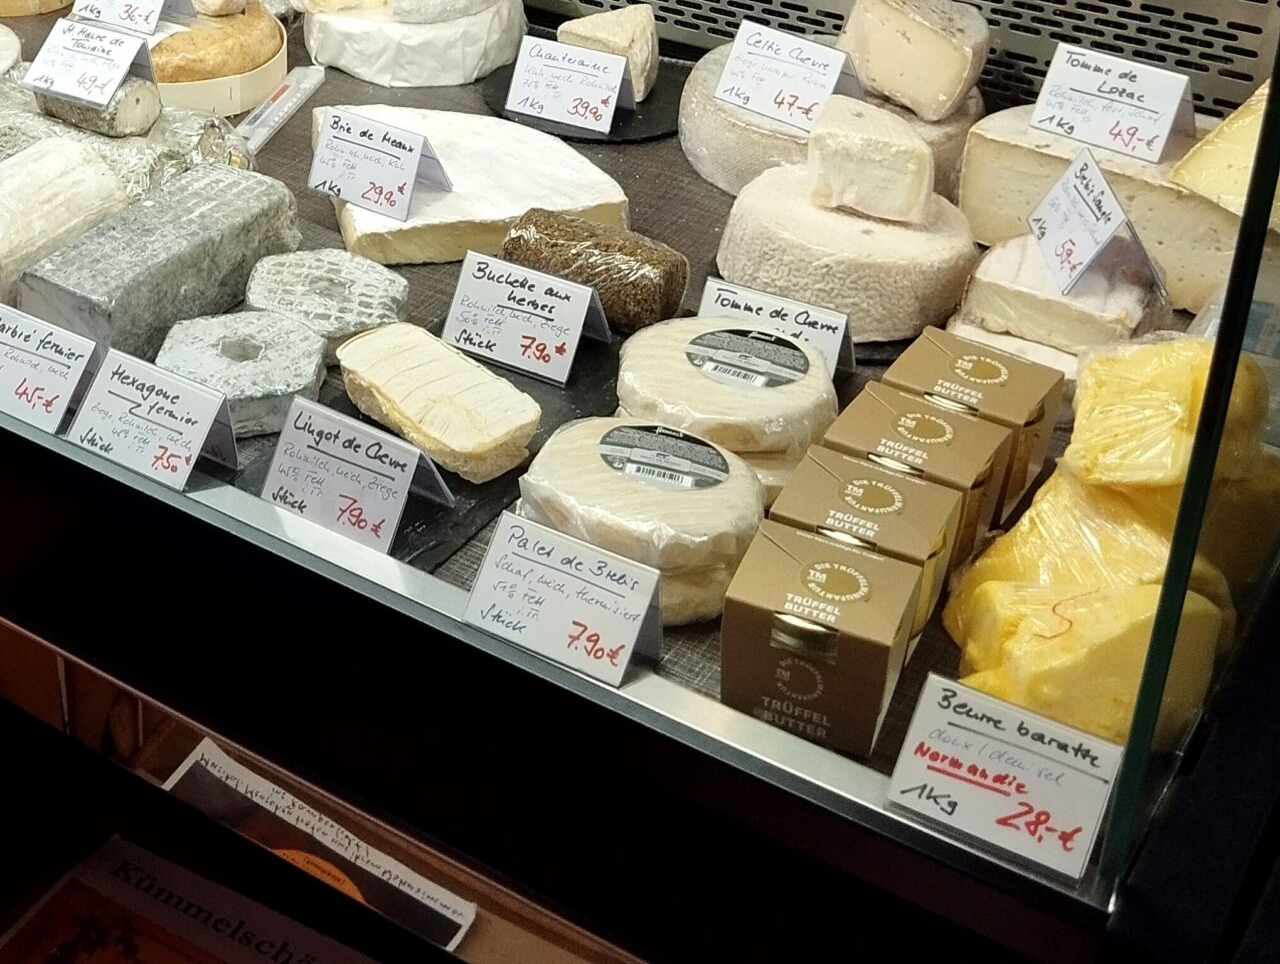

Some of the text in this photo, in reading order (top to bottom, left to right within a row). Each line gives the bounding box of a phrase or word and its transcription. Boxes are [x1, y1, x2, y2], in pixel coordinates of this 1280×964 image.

[109, 36, 125, 46] de
[746, 32, 781, 55] Celtic
[1066, 50, 1137, 83] Tomme de
[330, 115, 415, 154] Brie de Meaux
[543, 287, 572, 302] aux
[715, 288, 763, 316] Tomme
[769, 307, 788, 321] de
[36, 331, 85, 362] fermier
[454, 328, 497, 353] Stück
[111, 363, 181, 405] Hexagone
[933, 386, 978, 404] BUTTER
[935, 379, 983, 400] TRÜFFEL
[147, 401, 199, 427] fermier
[293, 410, 341, 447] Lingot
[342, 437, 362, 454] de
[876, 445, 924, 465] BUTTER
[879, 437, 929, 460] TRÜFFEL
[271, 486, 308, 514] Stück
[826, 517, 876, 538] BUTTER
[828, 509, 880, 532] TRÜFFEL
[507, 524, 640, 591] Palet de Brebis
[784, 602, 837, 623] BUTTER
[785, 593, 841, 615] TRÜFFEL
[480, 603, 527, 633] Stück
[761, 695, 831, 727] TRÜFFEL
[937, 687, 1100, 768] Beurre baratte
[913, 740, 1029, 795] Normandie
[995, 801, 1082, 852] 28,-€
